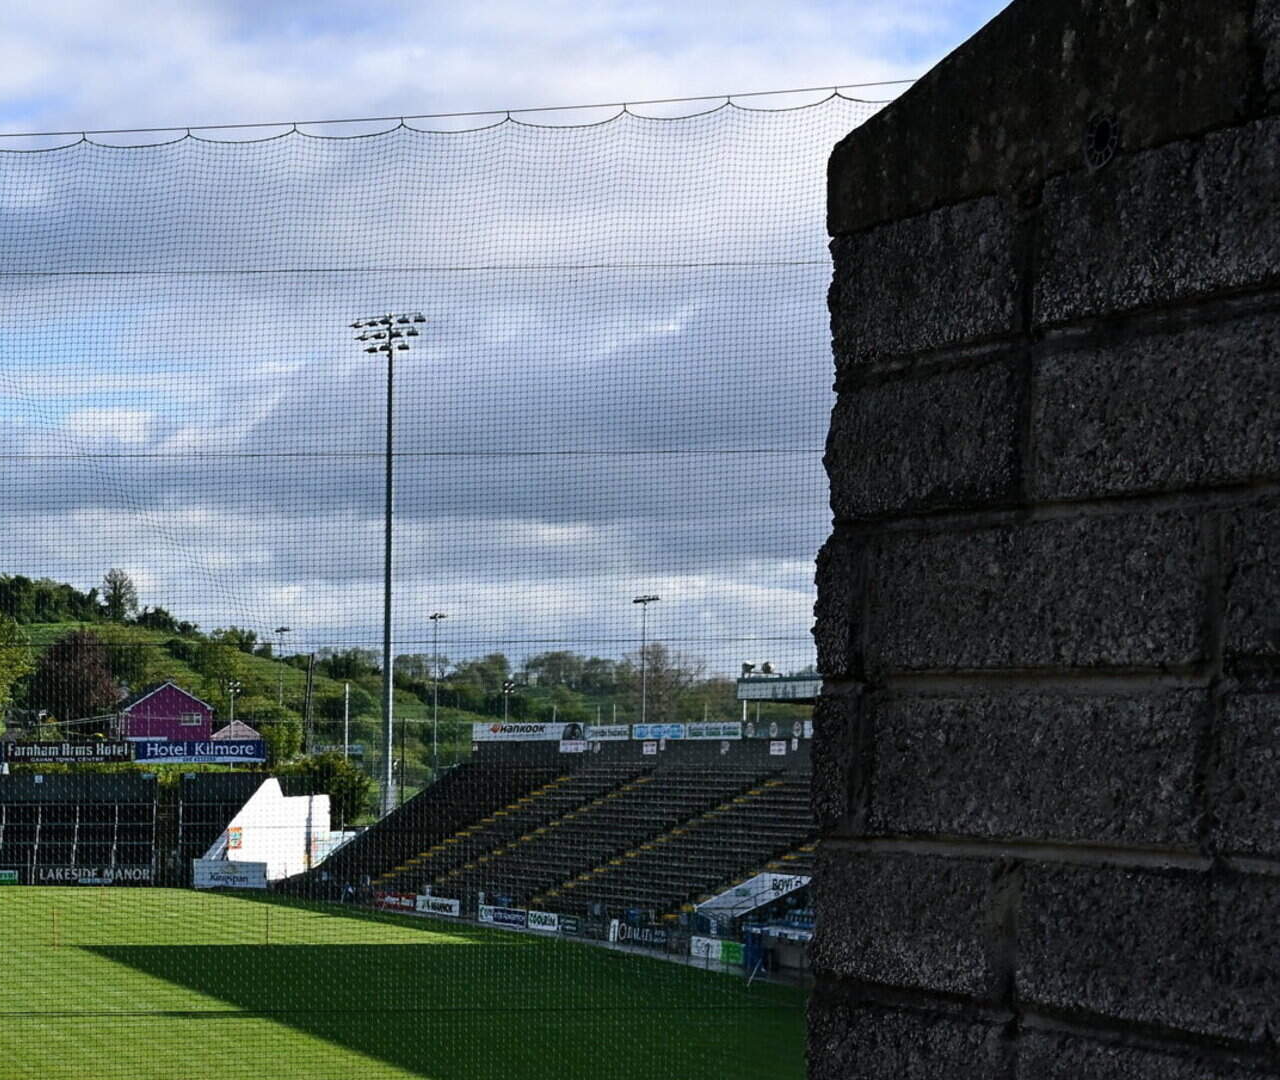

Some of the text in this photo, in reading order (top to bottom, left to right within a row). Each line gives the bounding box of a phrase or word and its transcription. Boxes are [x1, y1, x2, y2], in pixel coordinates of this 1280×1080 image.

[7, 743, 128, 756] Farnham Arms Hotel
[146, 742, 255, 756] Hotel Kilmore
[39, 868, 150, 880] LAKESIDE MANOR
